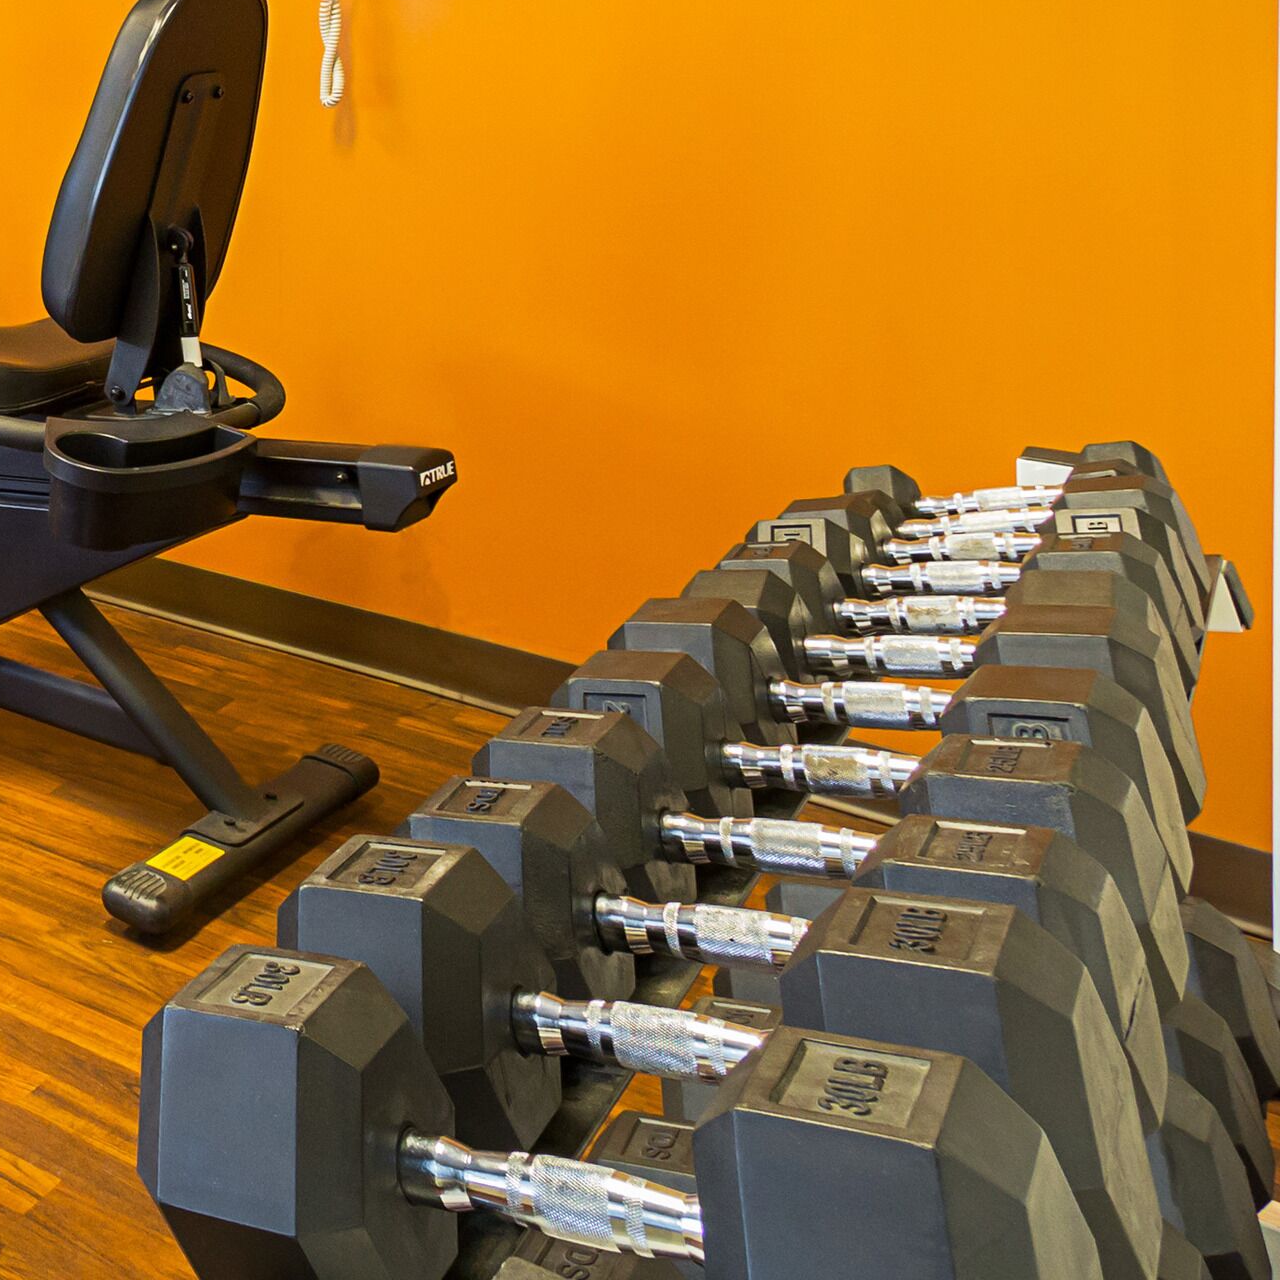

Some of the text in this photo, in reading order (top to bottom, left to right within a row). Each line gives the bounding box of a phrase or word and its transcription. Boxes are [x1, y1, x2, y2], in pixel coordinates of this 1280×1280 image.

[428, 461, 455, 483] TRUE
[231, 961, 301, 1006] 30LB
[818, 1057, 889, 1116] 30LB
